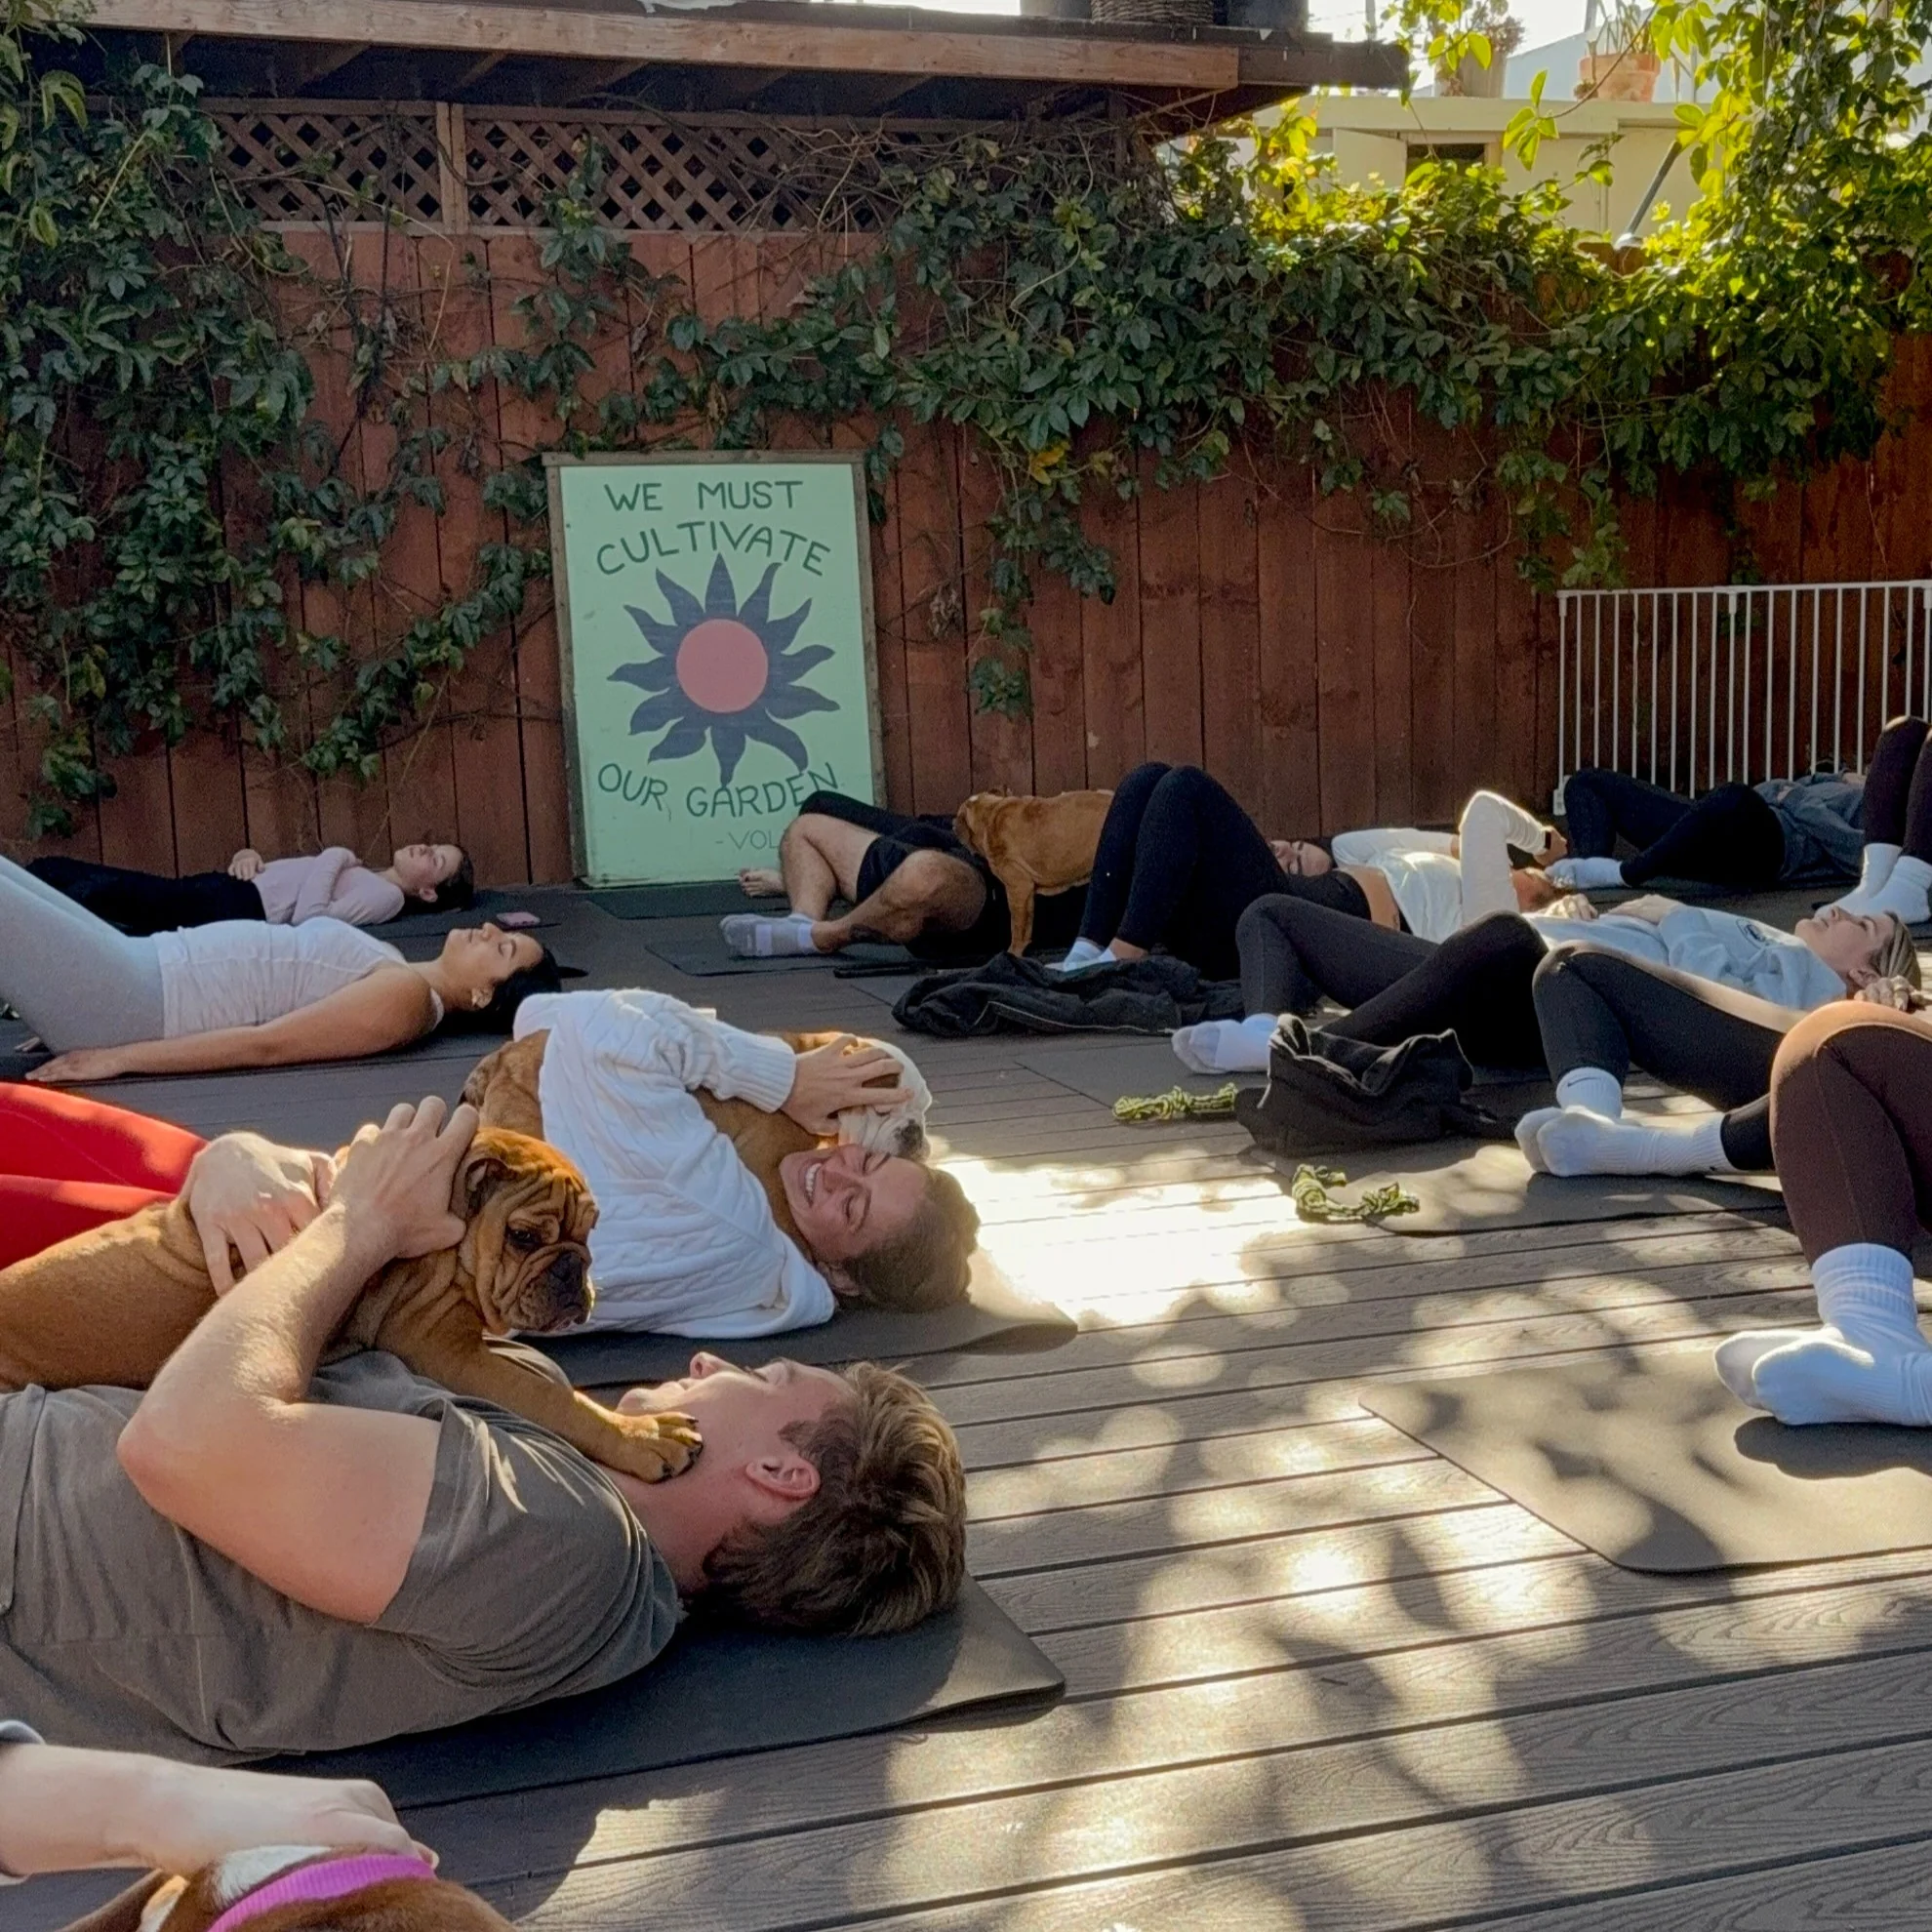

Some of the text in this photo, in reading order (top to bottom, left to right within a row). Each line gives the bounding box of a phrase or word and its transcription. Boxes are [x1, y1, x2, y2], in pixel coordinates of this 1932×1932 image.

[603, 480, 804, 511] WE MUST
[596, 520, 831, 577] CULTIVATE
[597, 762, 839, 818] OUR GARDEN
